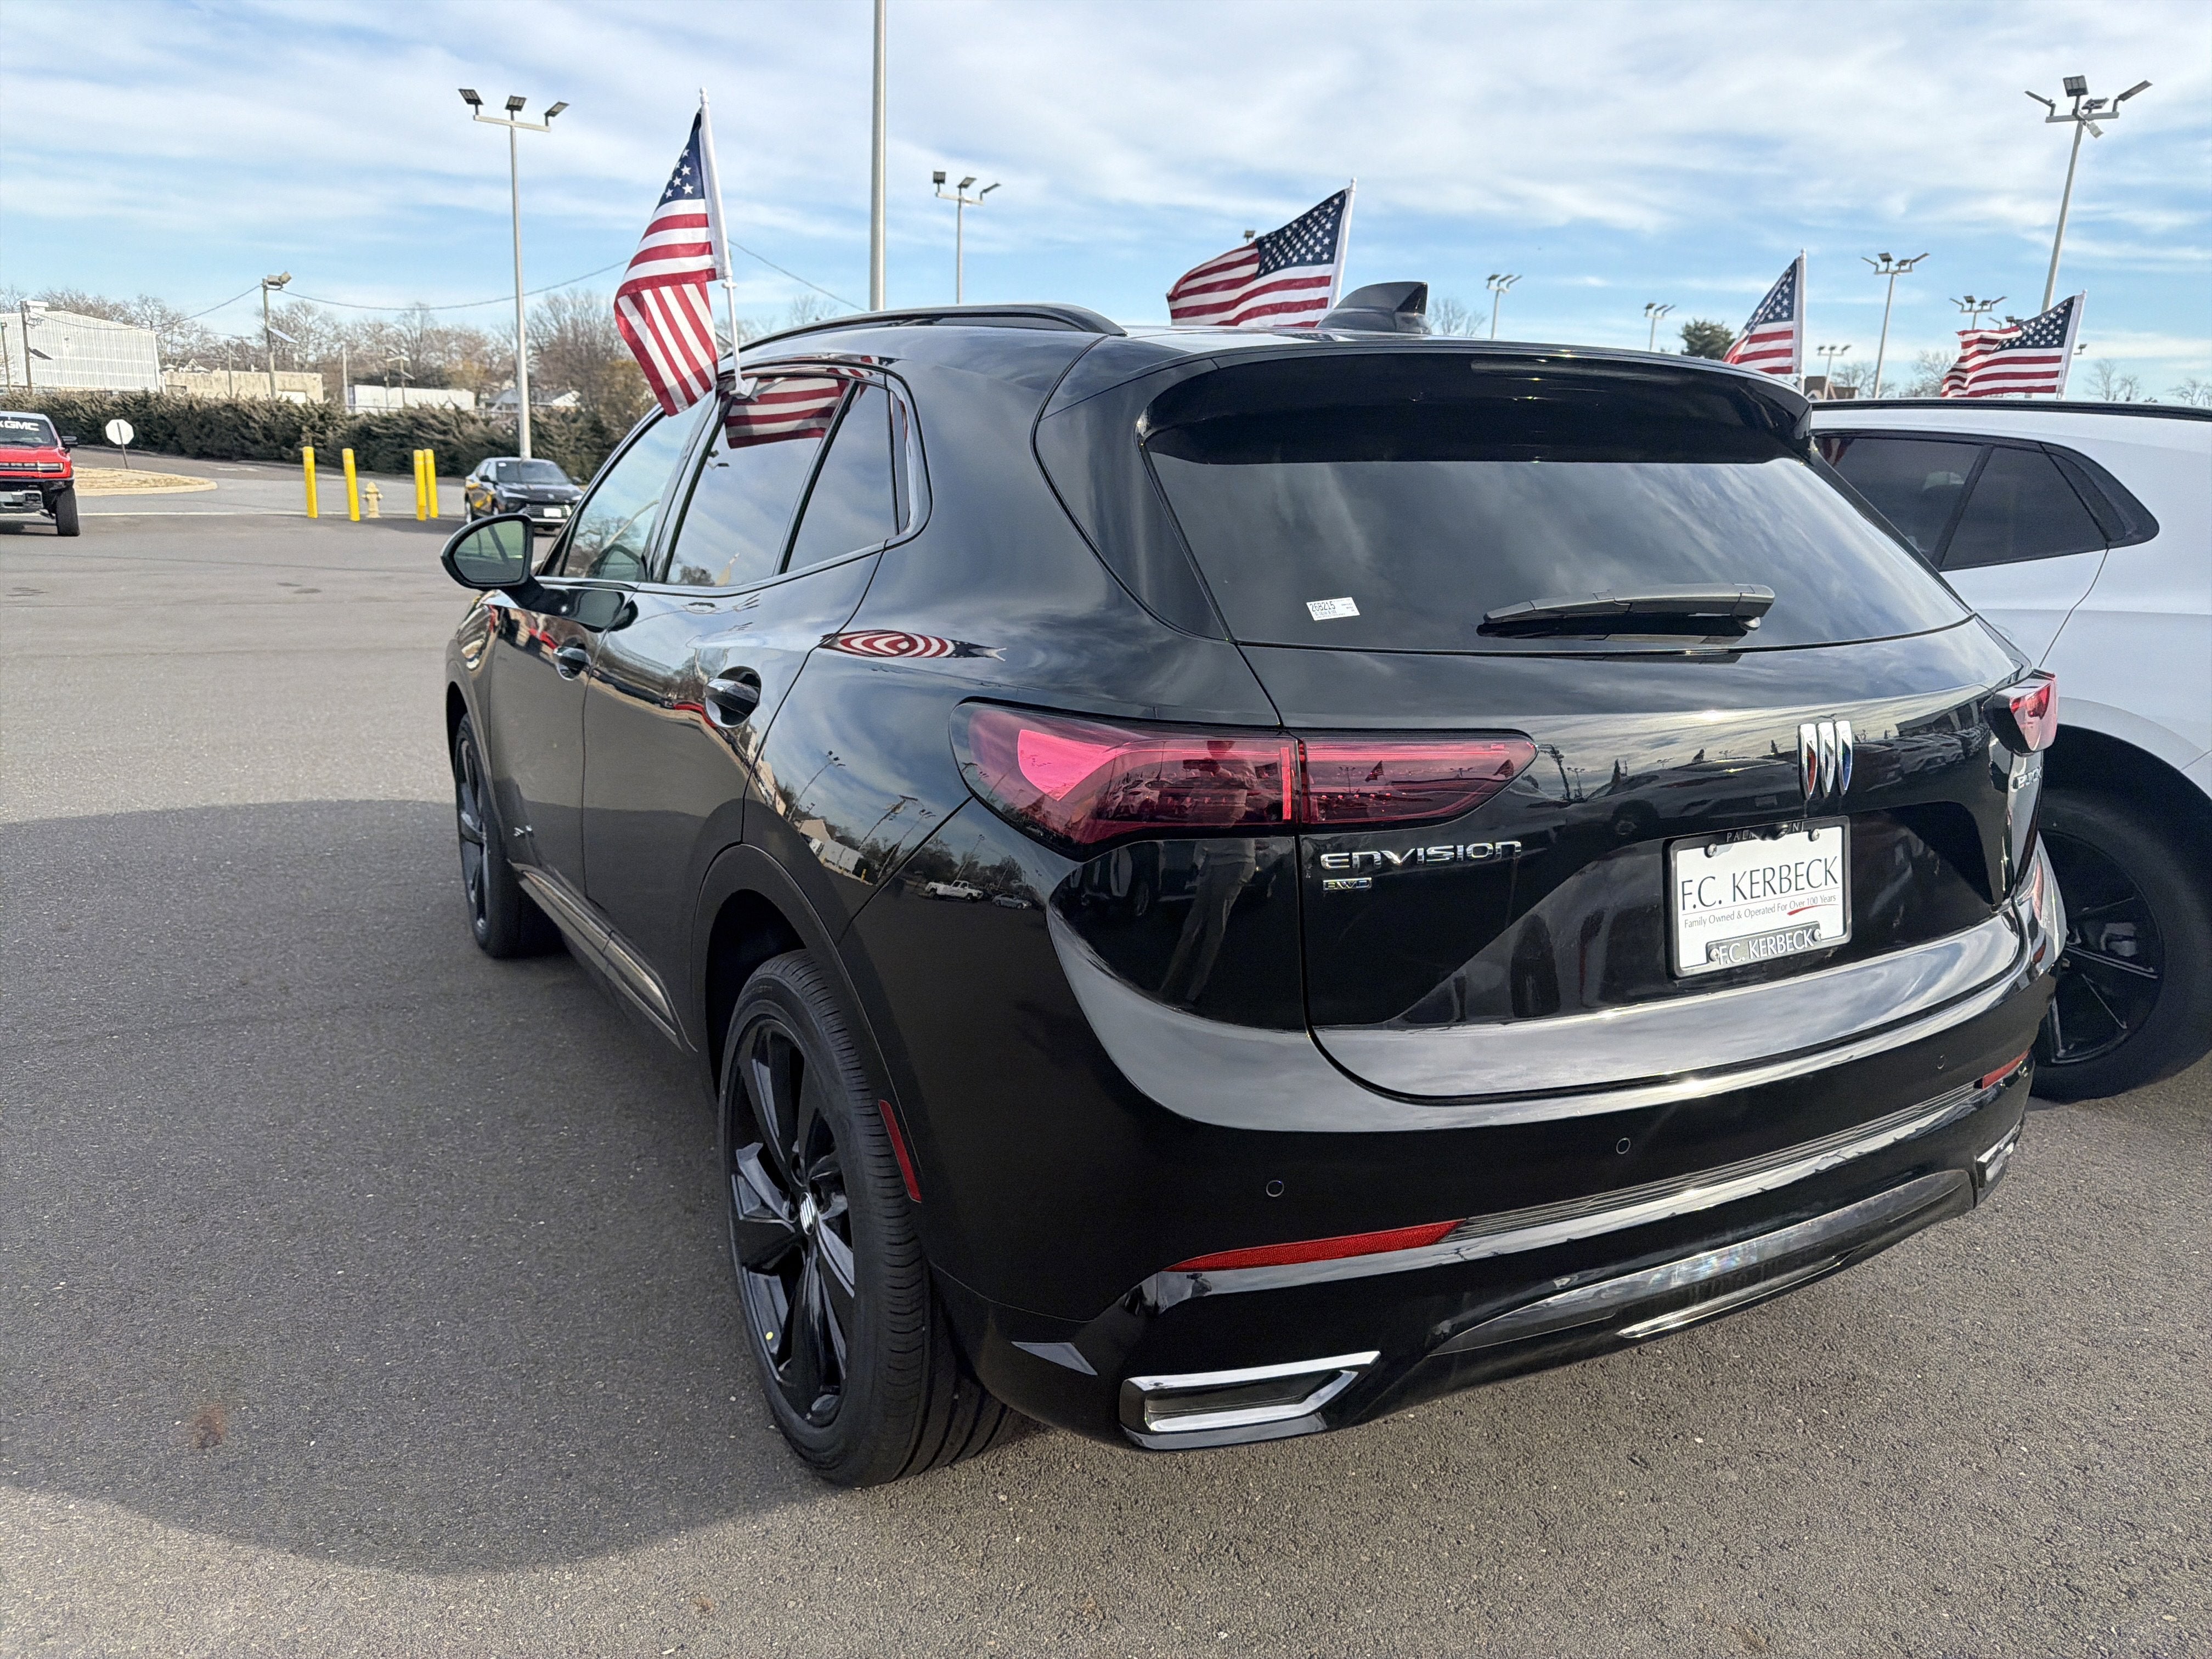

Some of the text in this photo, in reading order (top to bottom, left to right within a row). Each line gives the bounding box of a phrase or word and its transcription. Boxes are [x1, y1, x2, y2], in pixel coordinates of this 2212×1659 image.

[4, 420, 40, 431] GMC
[1792, 821, 1804, 832] NJ
[1320, 840, 1521, 870] ENVISION
[1681, 855, 1838, 911] F.C. KERBECK
[1684, 894, 1837, 928] Family Owned & Operated For Over 100 Years
[1718, 928, 1814, 966] F.C. KERBECK
